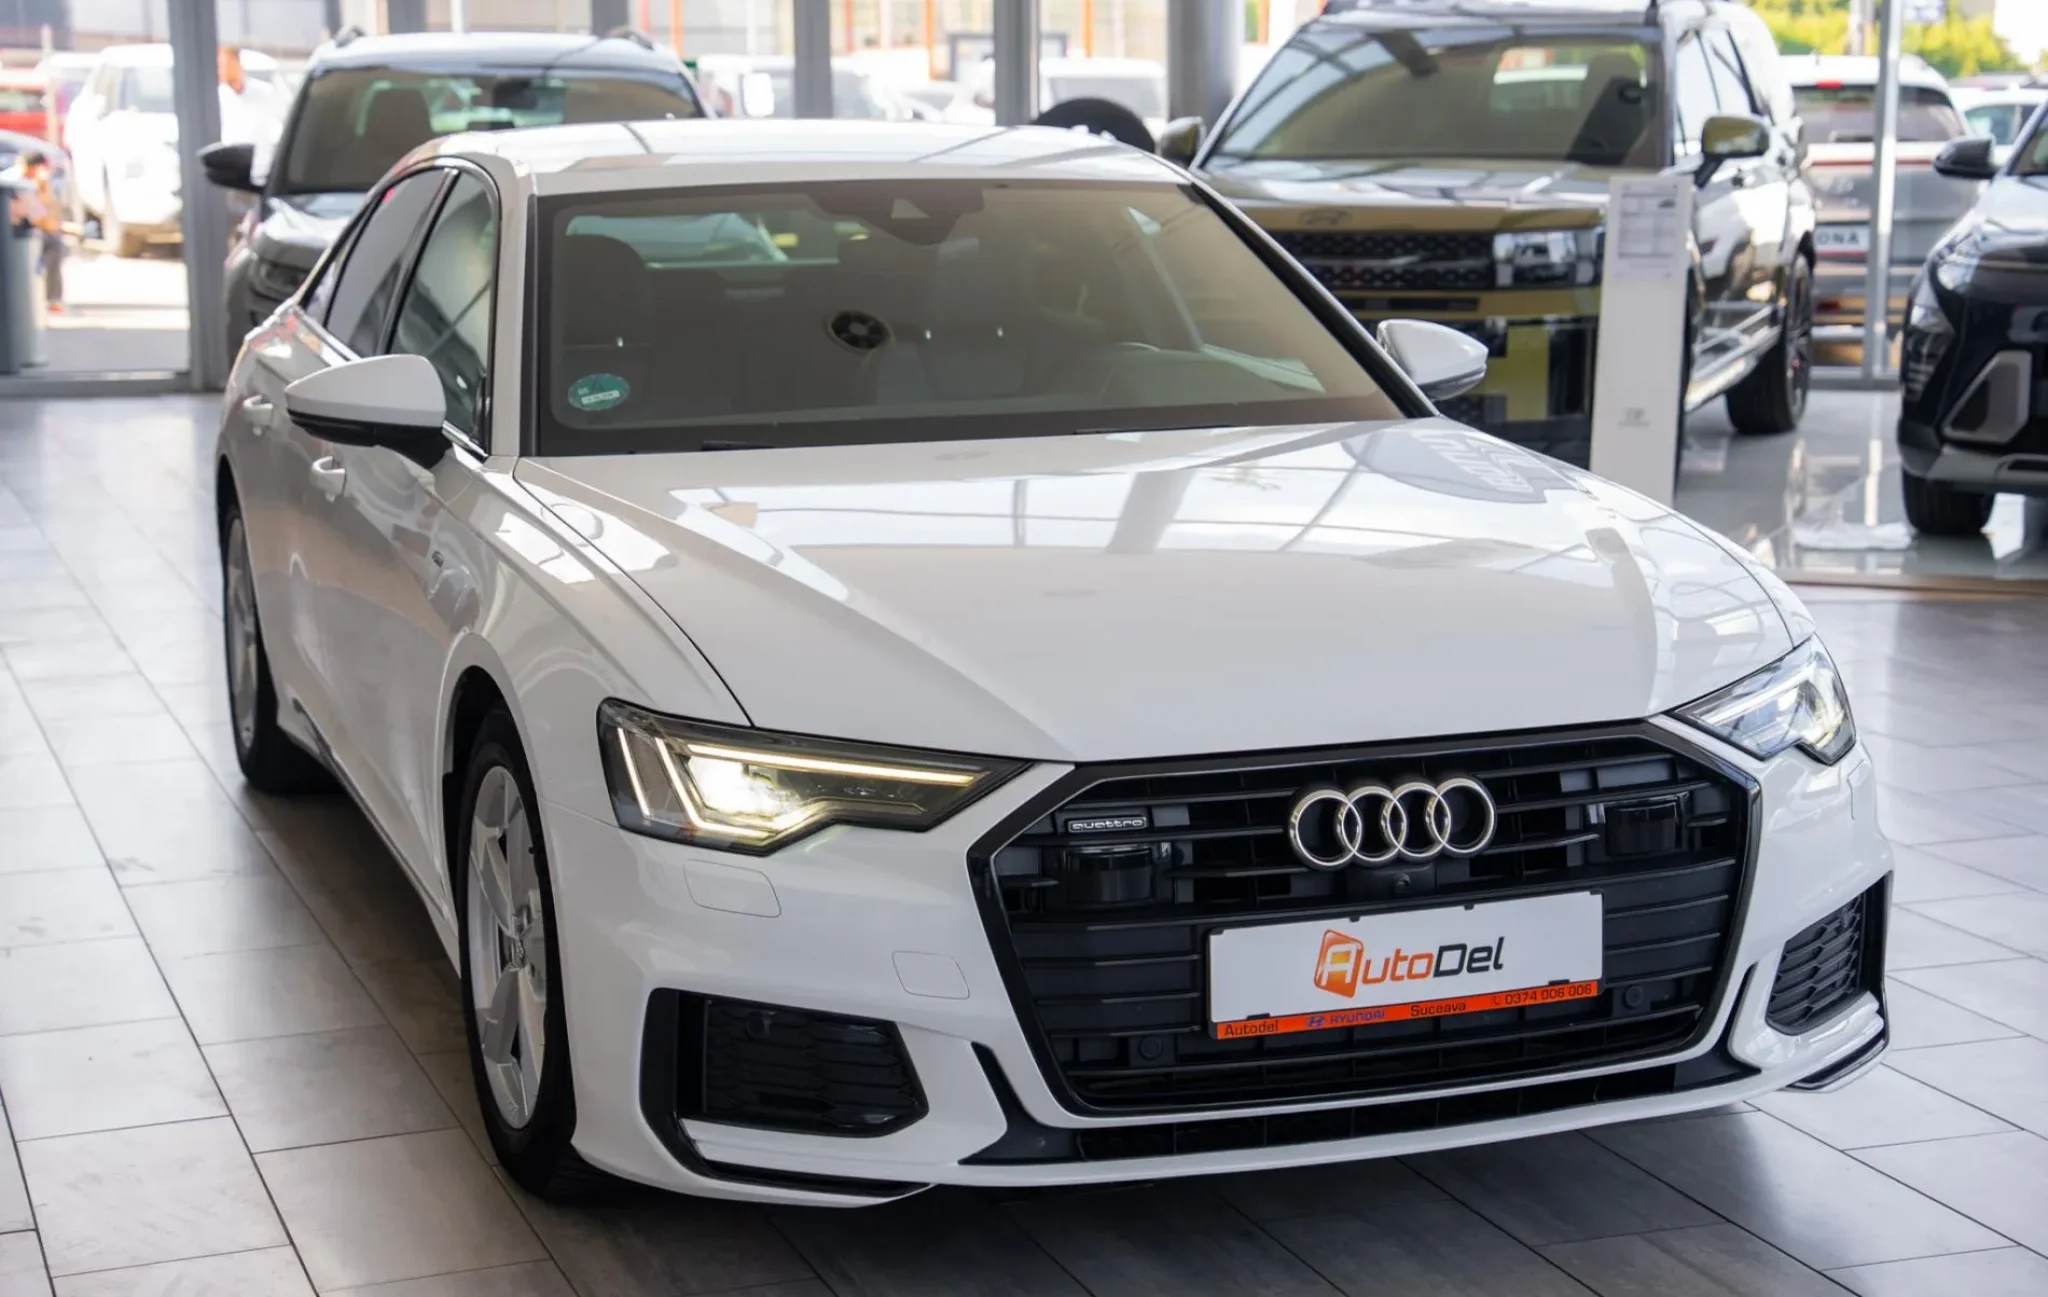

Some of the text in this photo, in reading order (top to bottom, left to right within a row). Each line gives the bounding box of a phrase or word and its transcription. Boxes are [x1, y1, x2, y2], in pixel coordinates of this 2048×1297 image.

[1817, 230, 1860, 245] ONA
[1072, 819, 1143, 832] quattro
[1317, 934, 1505, 990] AutoDel
[1223, 1020, 1279, 1037] Autodel
[1329, 1010, 1385, 1025] HYUNDAI
[1410, 1001, 1467, 1017] Suceava
[1505, 991, 1538, 1006] 0374
